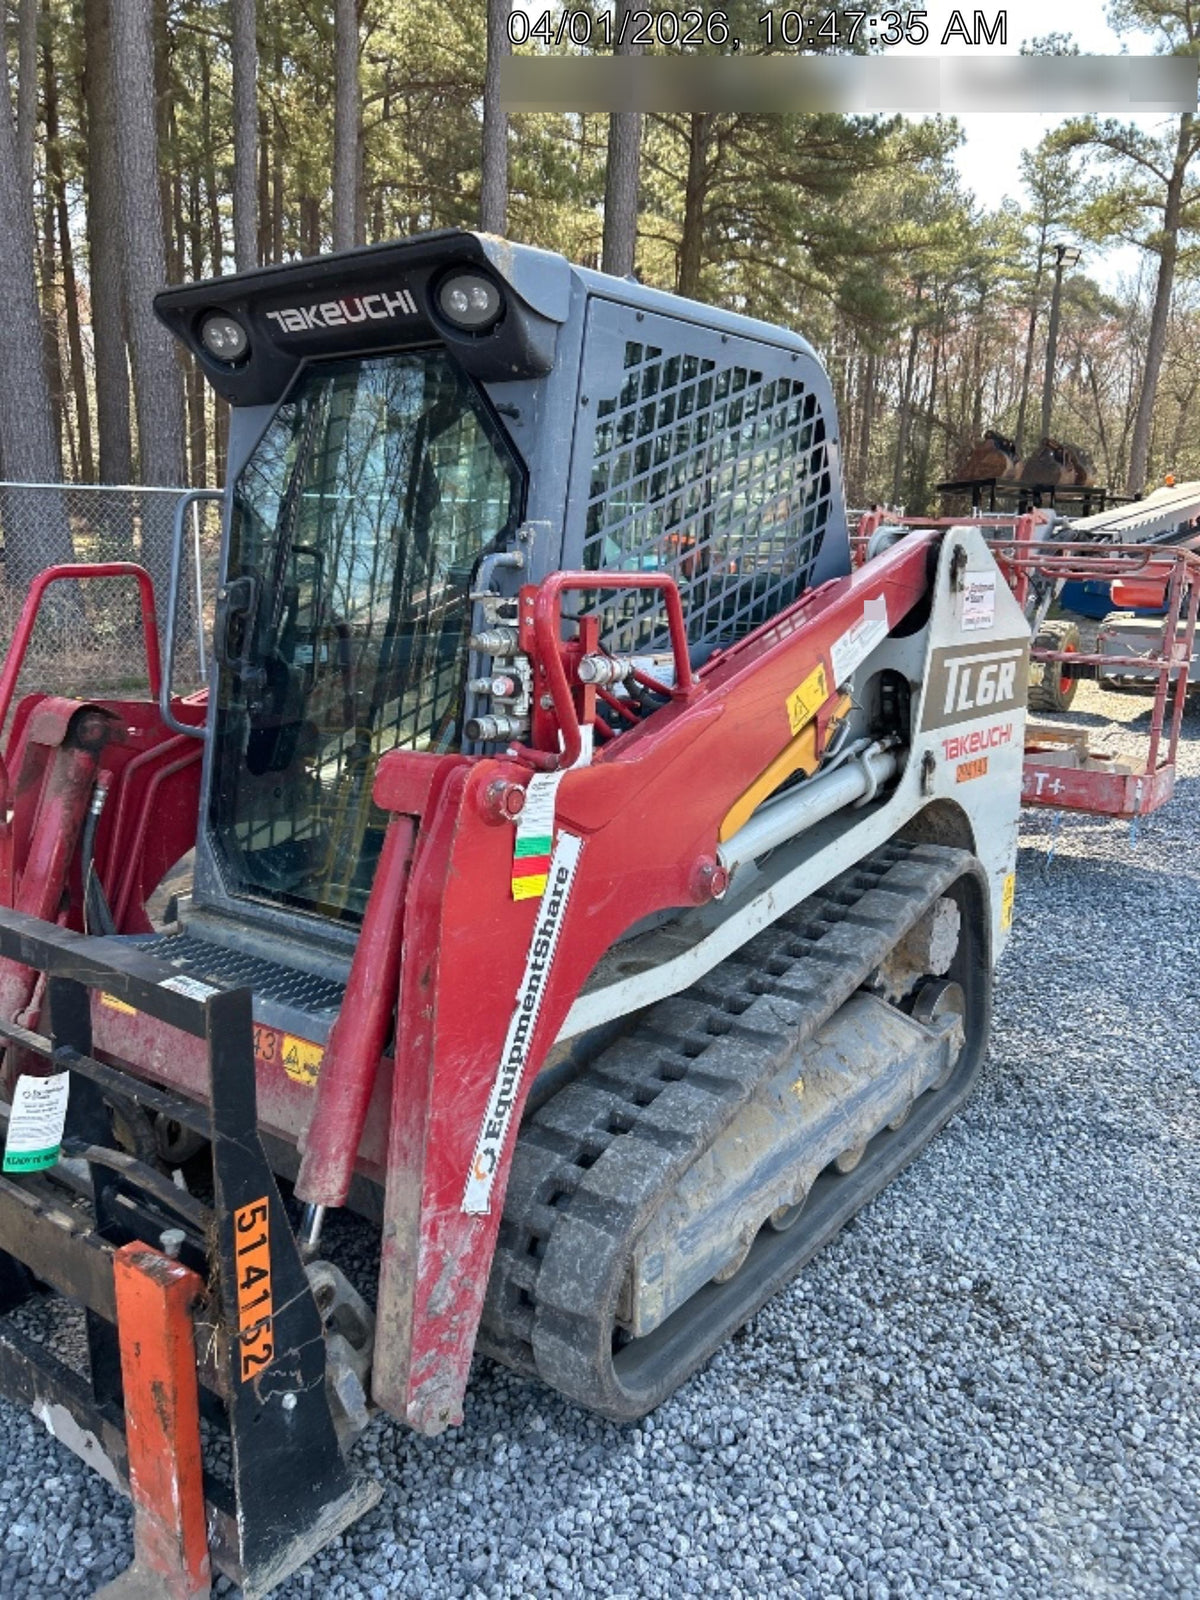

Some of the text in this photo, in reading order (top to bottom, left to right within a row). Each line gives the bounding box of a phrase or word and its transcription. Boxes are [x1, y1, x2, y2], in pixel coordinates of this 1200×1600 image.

[266, 289, 418, 333] TAKEUCHI
[943, 648, 1023, 716] TL6R
[942, 723, 1012, 760] TAKEUCHI
[484, 865, 570, 1141] EquipmentShare
[237, 1204, 273, 1375] 514152
